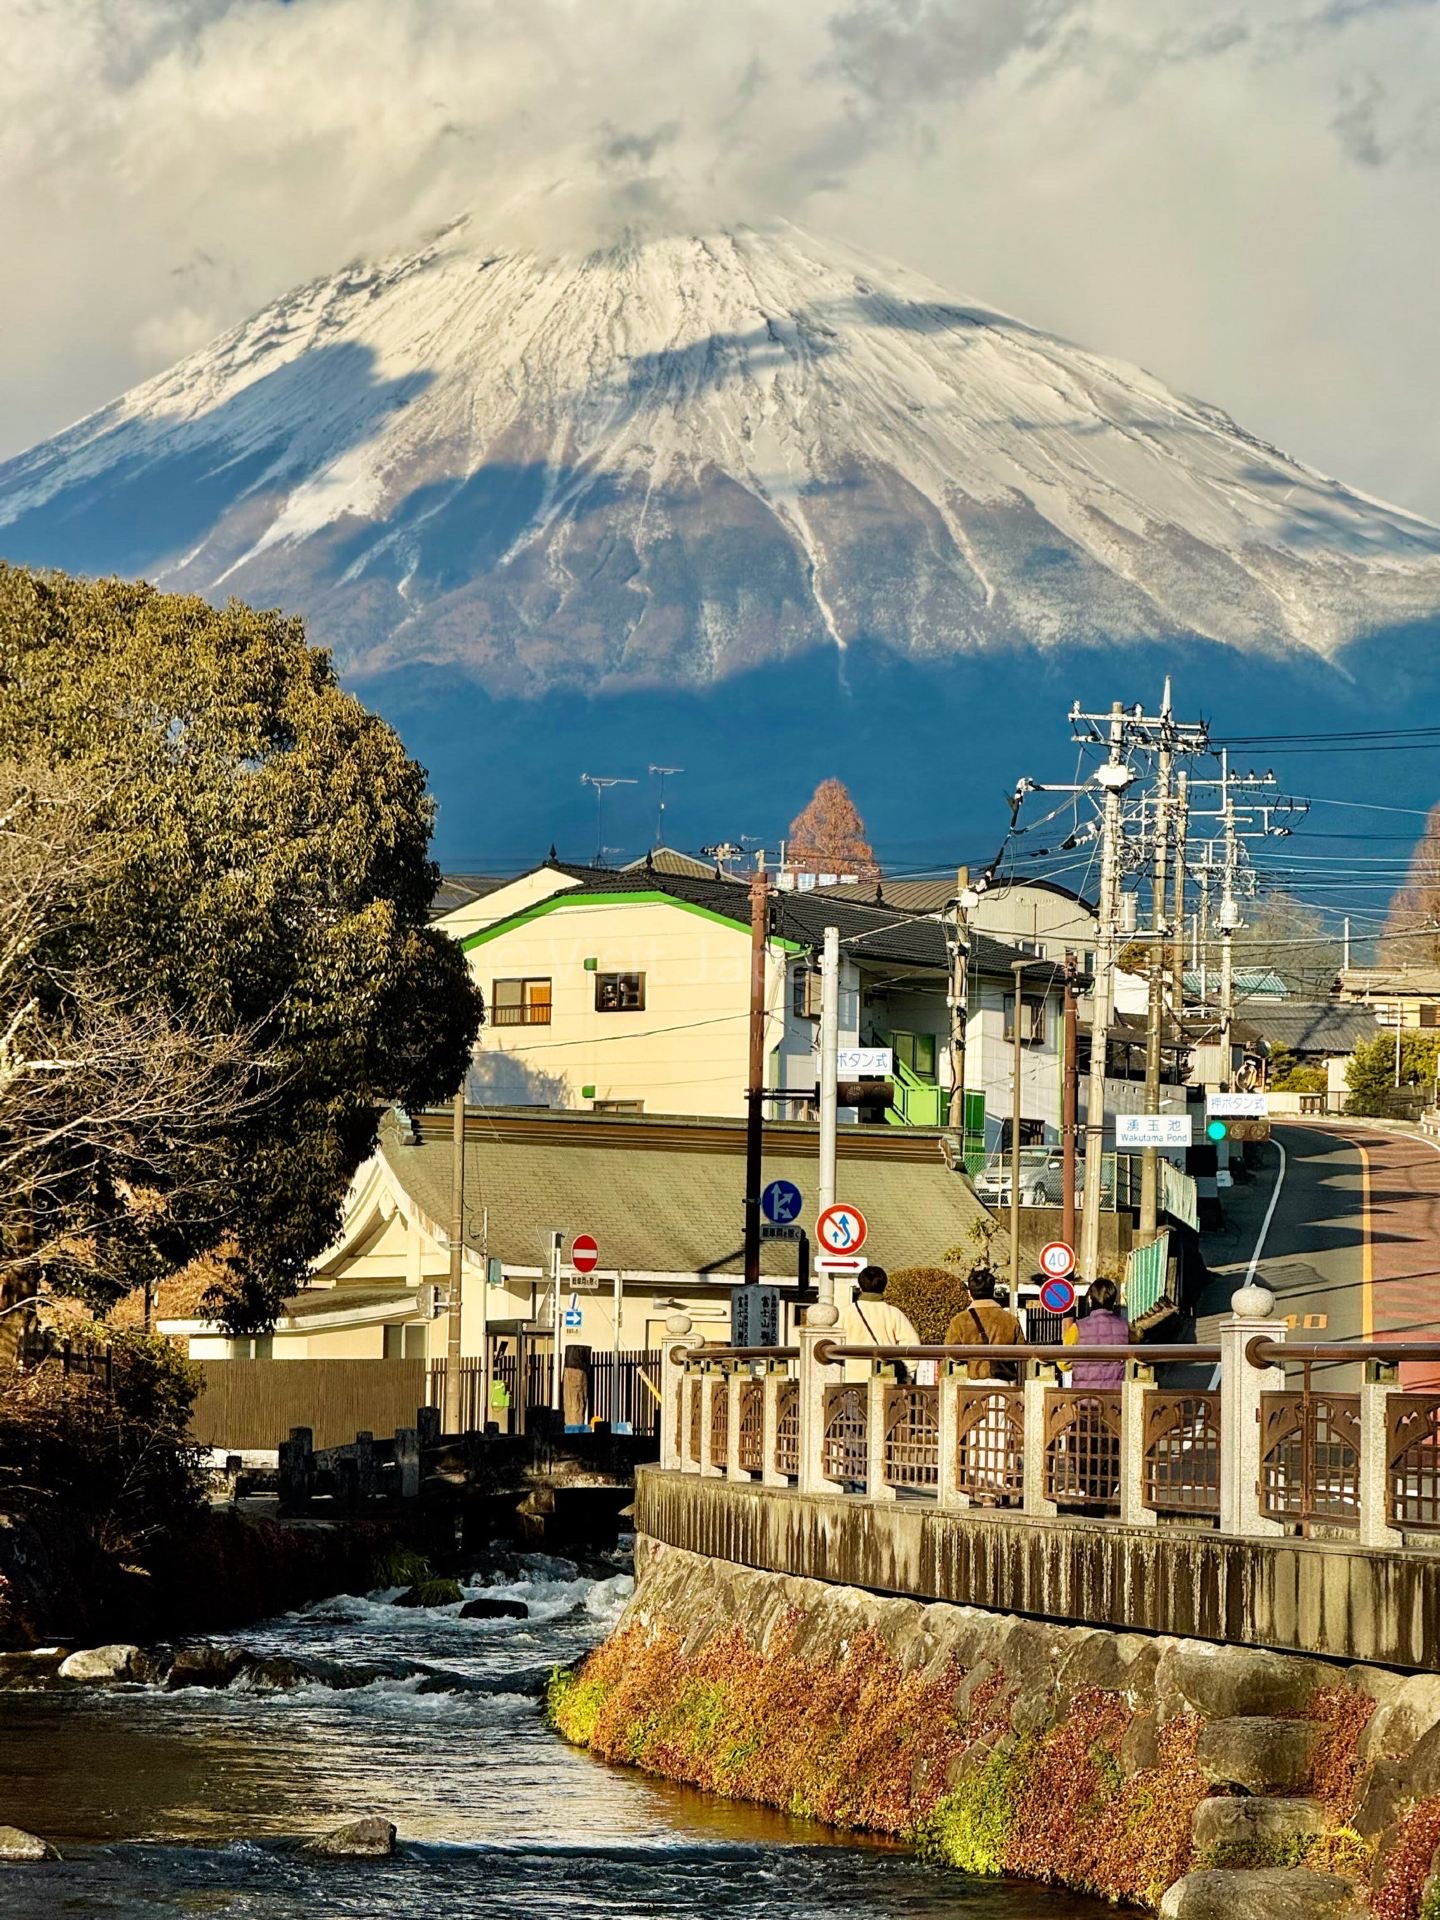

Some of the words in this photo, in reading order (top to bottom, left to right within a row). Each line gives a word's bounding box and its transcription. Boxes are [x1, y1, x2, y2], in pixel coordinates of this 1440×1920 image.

[837, 1052, 888, 1069] ボタン式
[1211, 1097, 1265, 1111] 押ボタン式
[1126, 1119, 1182, 1132] 湧玉池
[1120, 1134, 1164, 1143] Wakutama
[1167, 1134, 1188, 1143] Pond
[1048, 1252, 1067, 1268] 40
